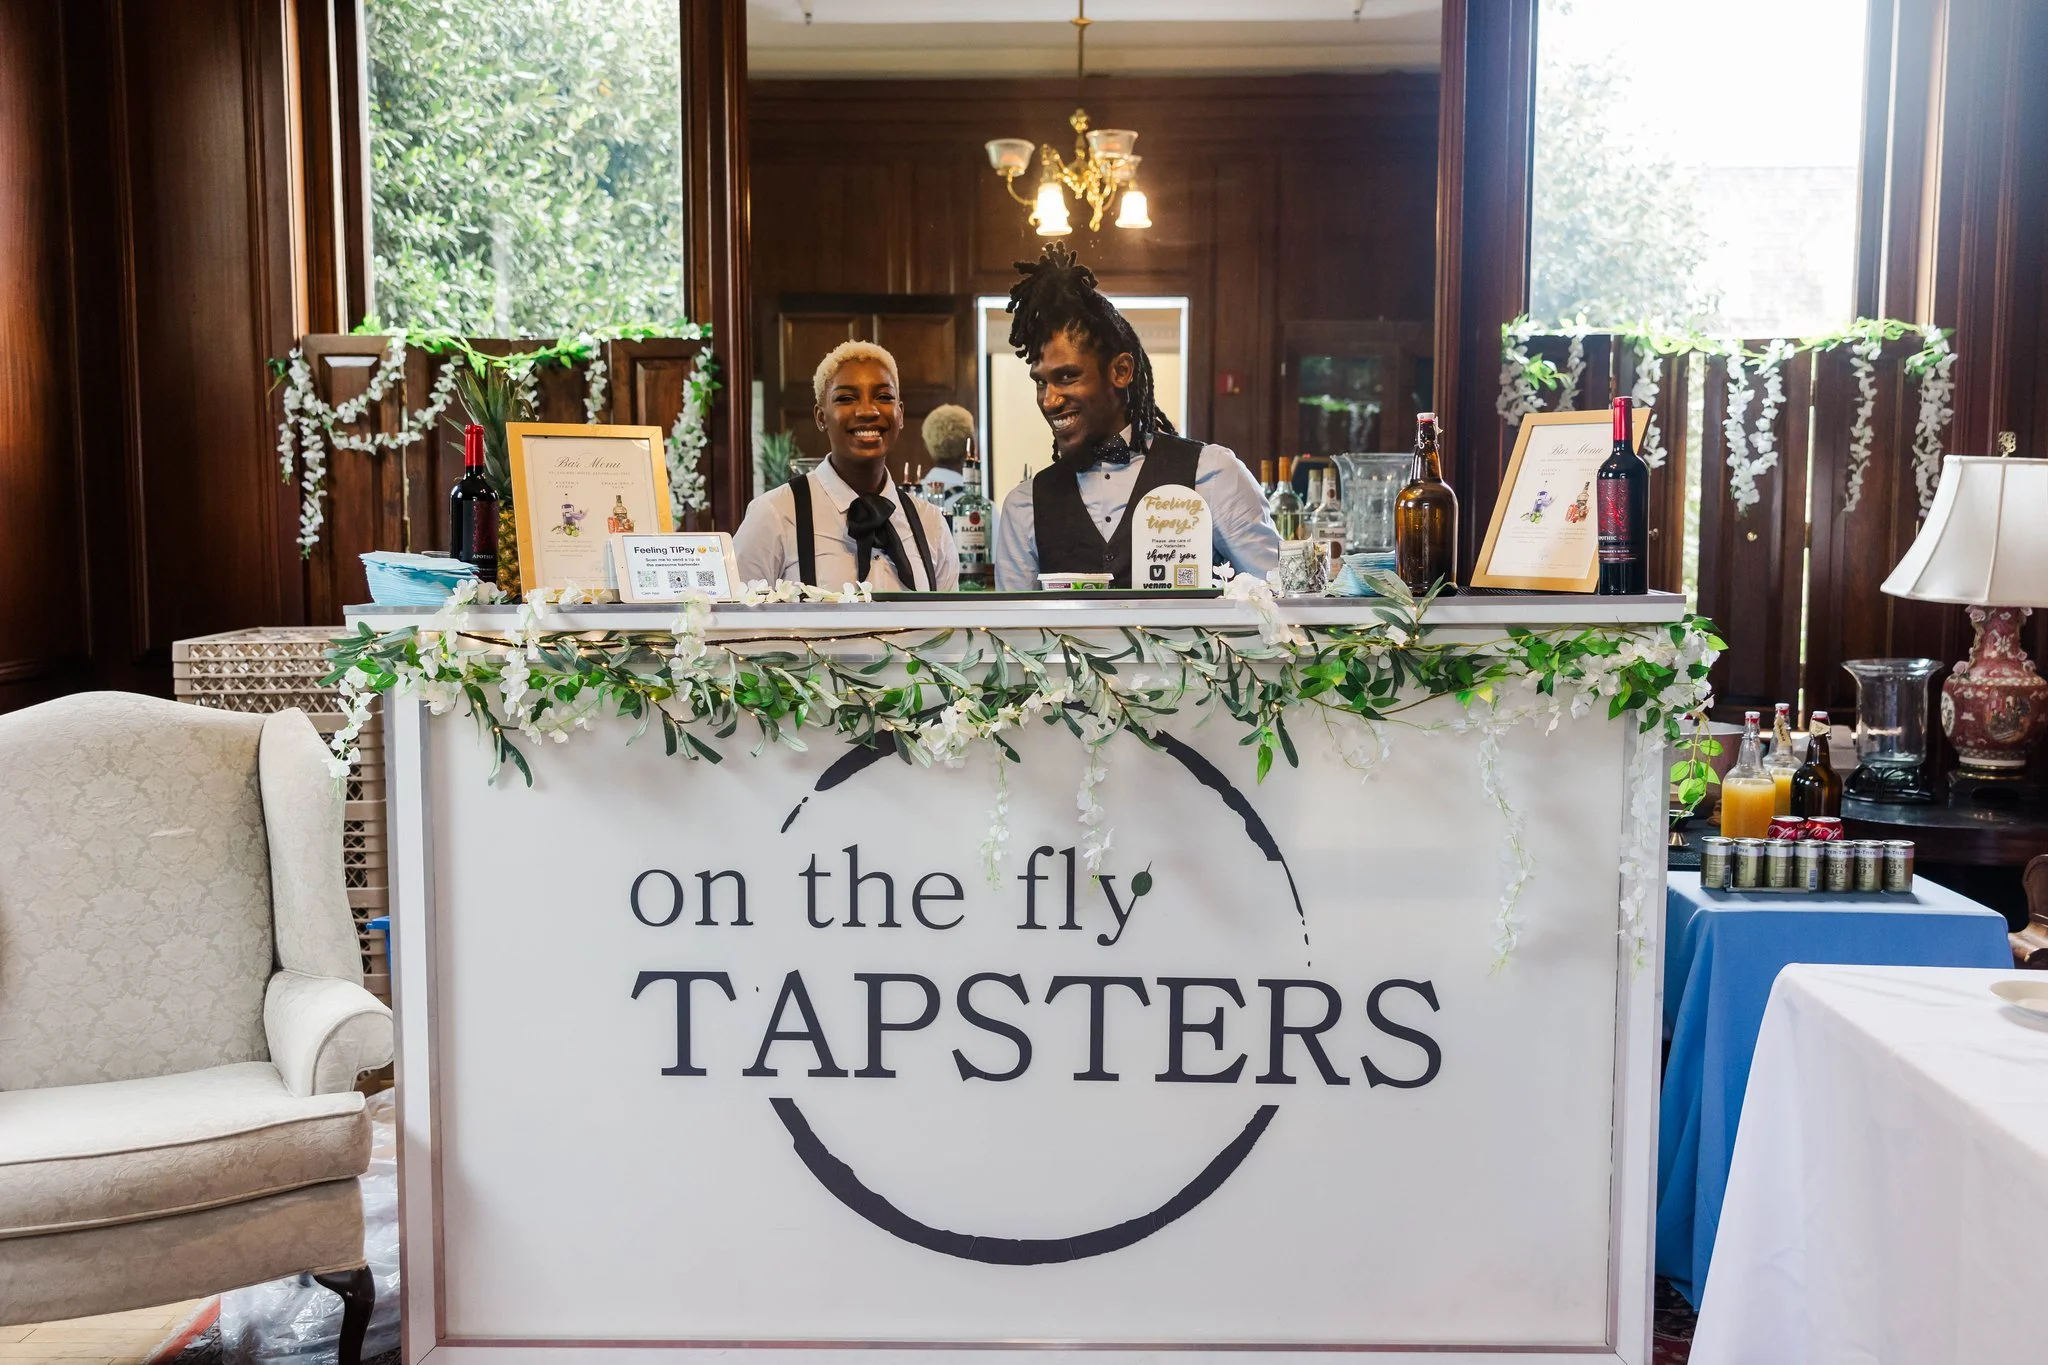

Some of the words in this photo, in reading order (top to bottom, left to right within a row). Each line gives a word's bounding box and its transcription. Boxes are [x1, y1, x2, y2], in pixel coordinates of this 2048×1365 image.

[555, 457, 581, 468] Bar
[586, 456, 622, 469] Menu
[1143, 495, 1204, 515] Feeling
[1146, 515, 1200, 535] tipsy?
[634, 546, 668, 555] Feeling
[1146, 549, 1176, 563] thank
[1178, 552, 1197, 563] you
[631, 869, 754, 928] on
[799, 843, 966, 930] the
[1016, 844, 1152, 947] fly
[630, 969, 1443, 1090] TAPSTERS
